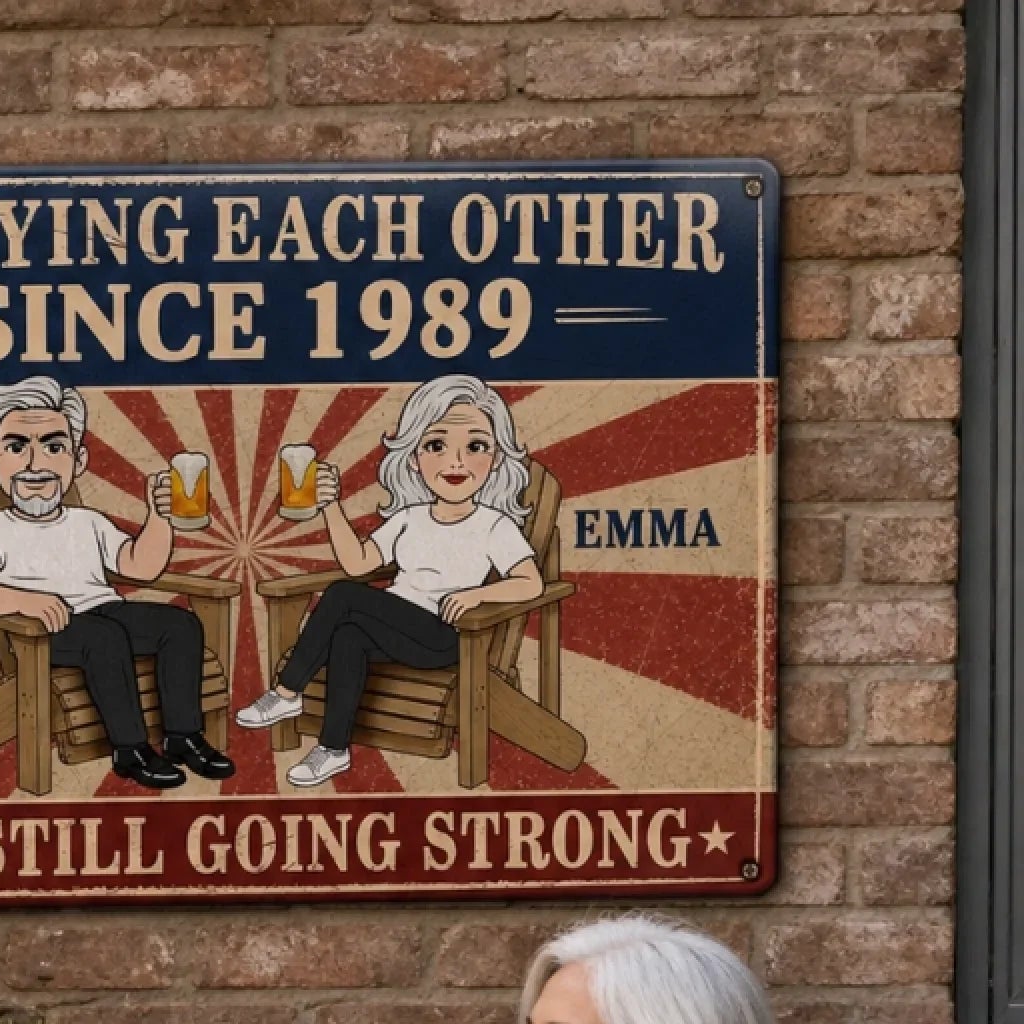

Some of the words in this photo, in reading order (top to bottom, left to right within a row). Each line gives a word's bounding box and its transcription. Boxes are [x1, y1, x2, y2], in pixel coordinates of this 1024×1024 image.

[211, 193, 425, 263] EACH
[450, 192, 725, 274] OTHER
[305, 276, 533, 361] 1989
[574, 508, 721, 549] EMMA
[185, 811, 401, 875] GOING
[422, 806, 693, 872] STRONG
